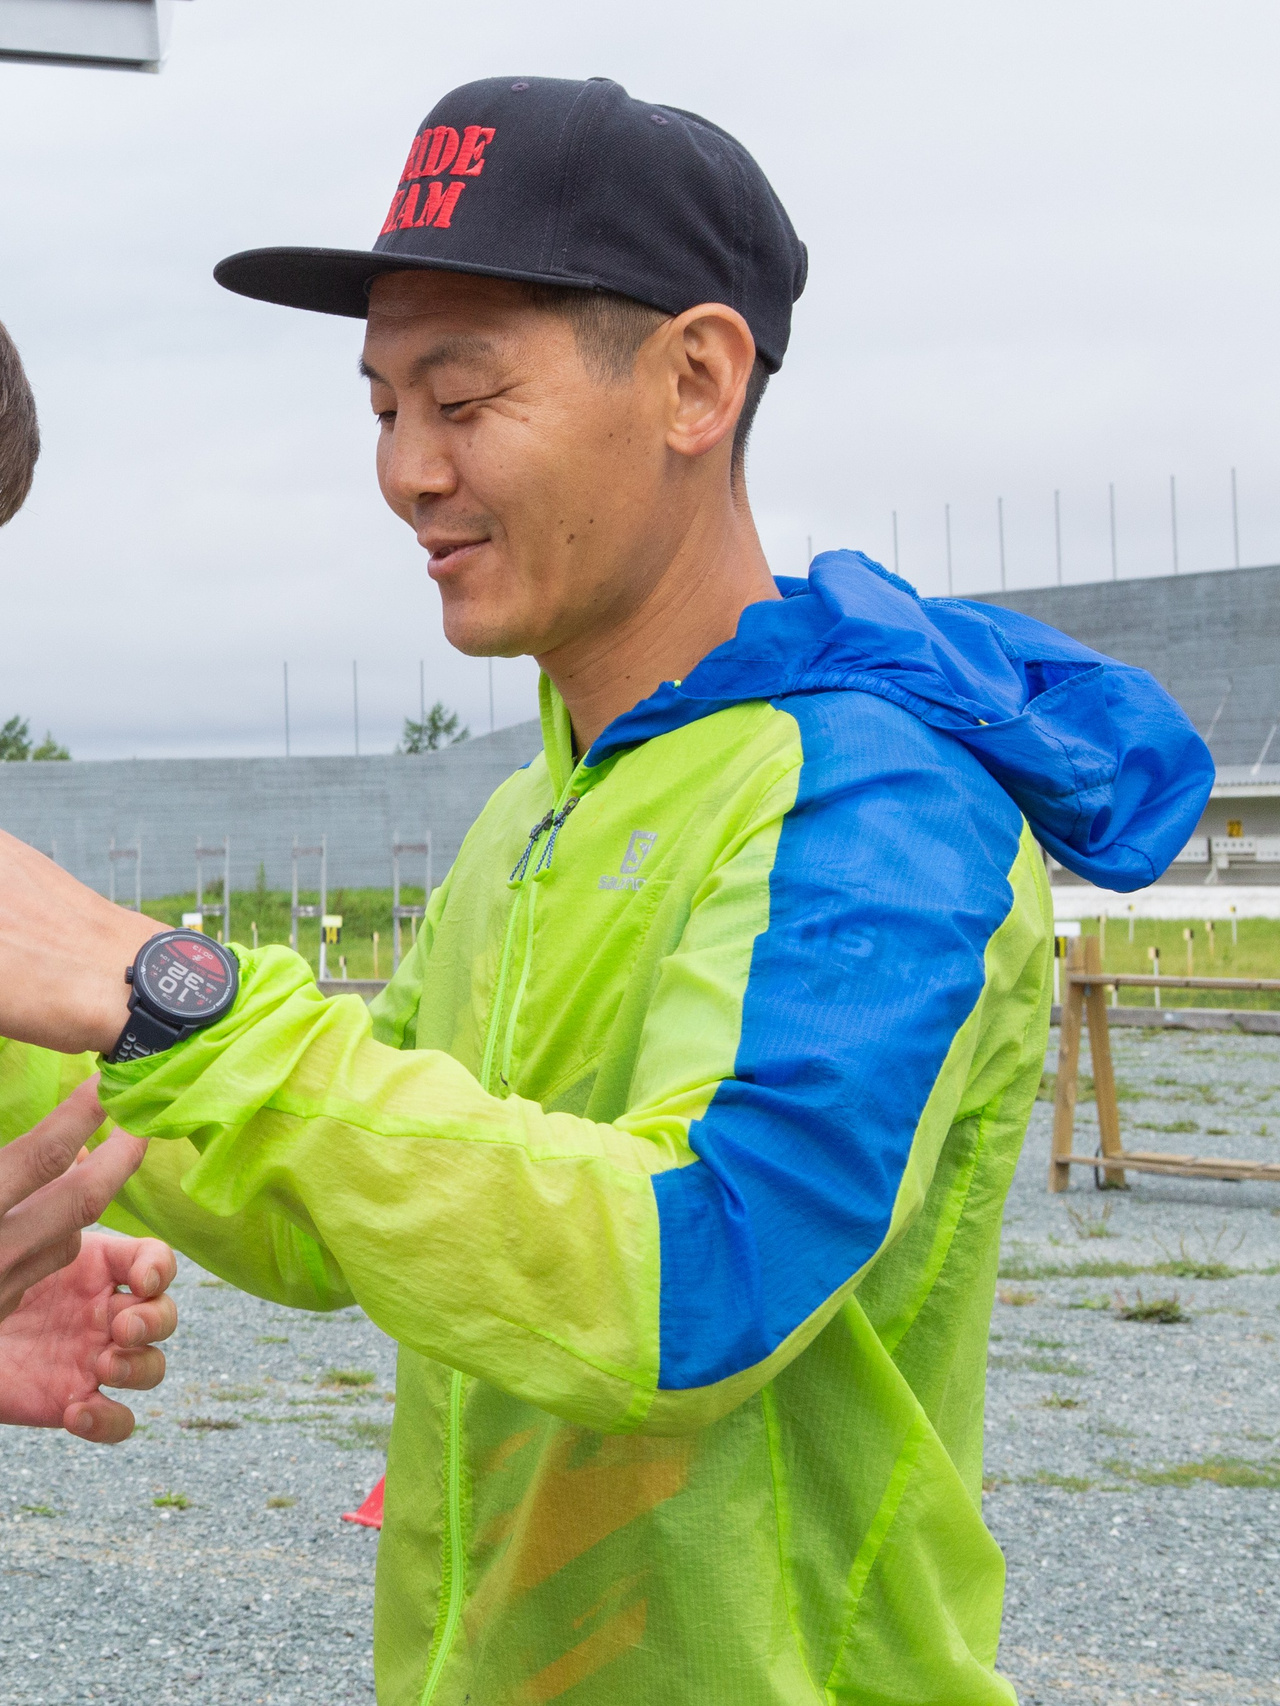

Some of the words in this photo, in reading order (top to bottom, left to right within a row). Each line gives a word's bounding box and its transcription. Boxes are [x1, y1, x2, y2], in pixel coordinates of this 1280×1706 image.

[380, 181, 466, 236] EAM
[158, 975, 189, 1002] 10
[167, 960, 204, 990] 32
